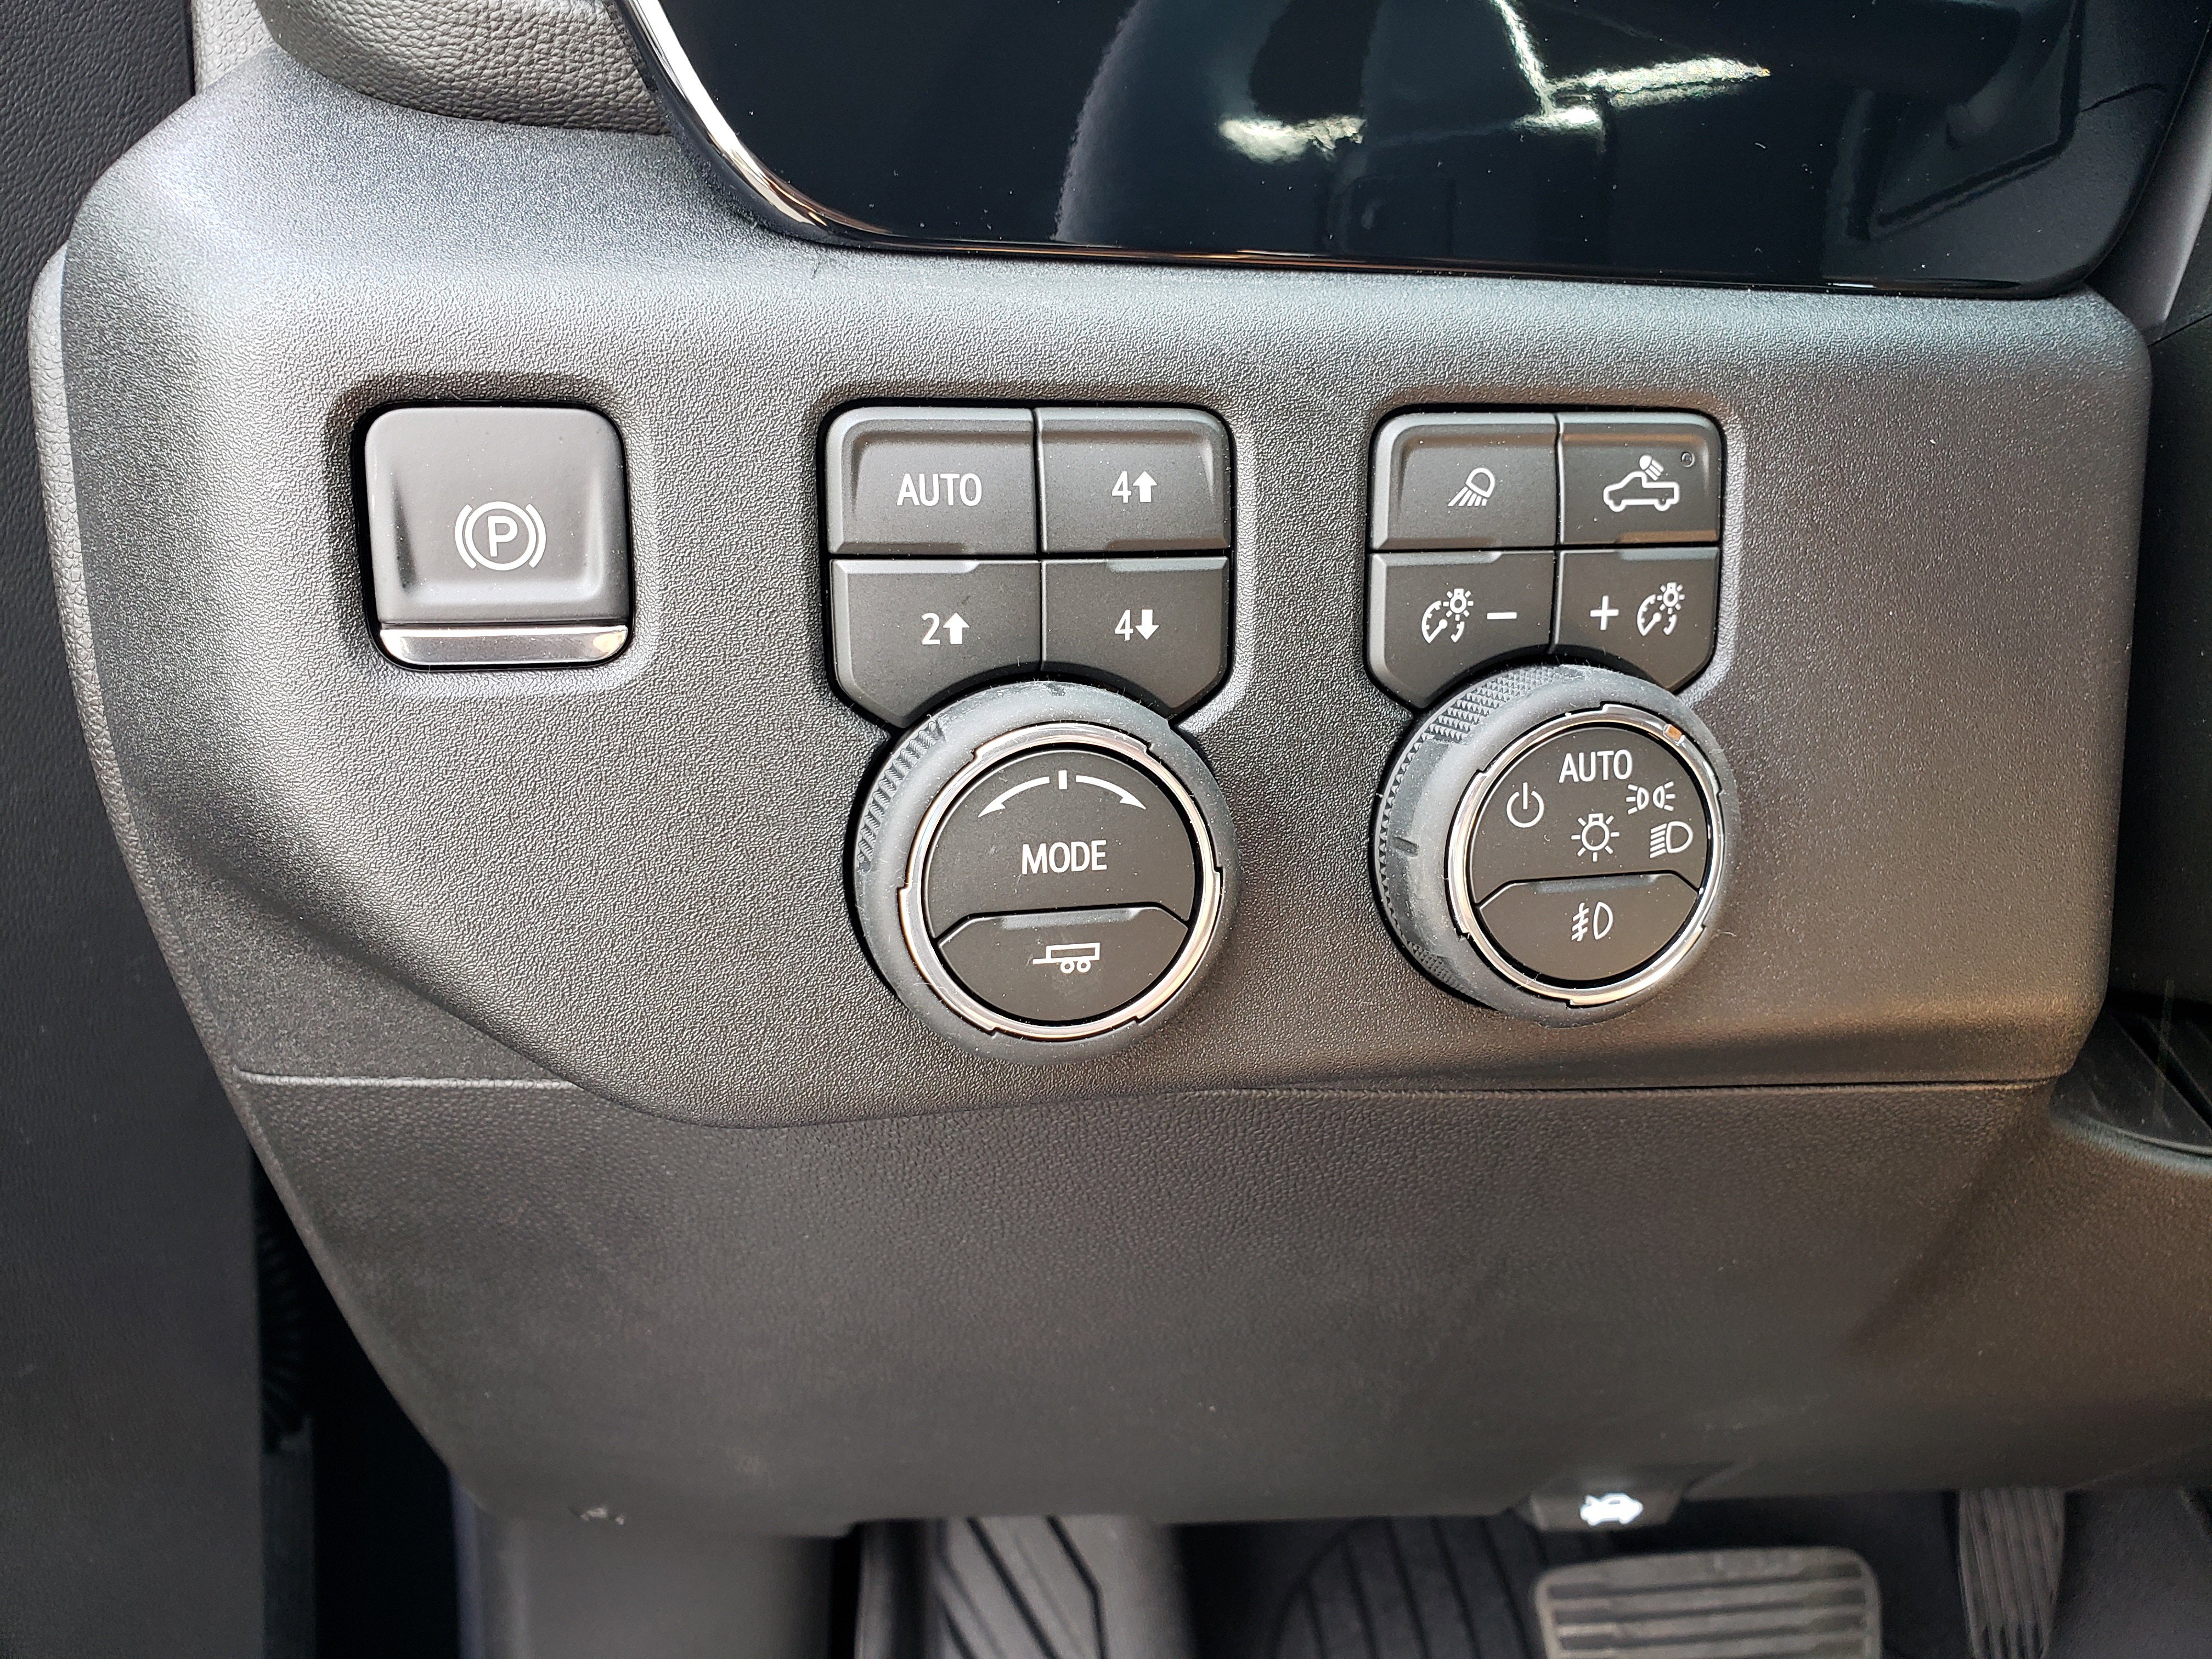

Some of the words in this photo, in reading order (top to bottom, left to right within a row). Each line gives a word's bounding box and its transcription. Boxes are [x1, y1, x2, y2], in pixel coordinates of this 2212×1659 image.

[896, 473, 983, 506] AUTO
[1111, 471, 1132, 504] 4
[487, 515, 519, 557] P
[921, 612, 943, 646] 2
[1114, 609, 1134, 642] 4
[1558, 749, 1633, 783] AUTO
[1022, 839, 1108, 875] MODE
